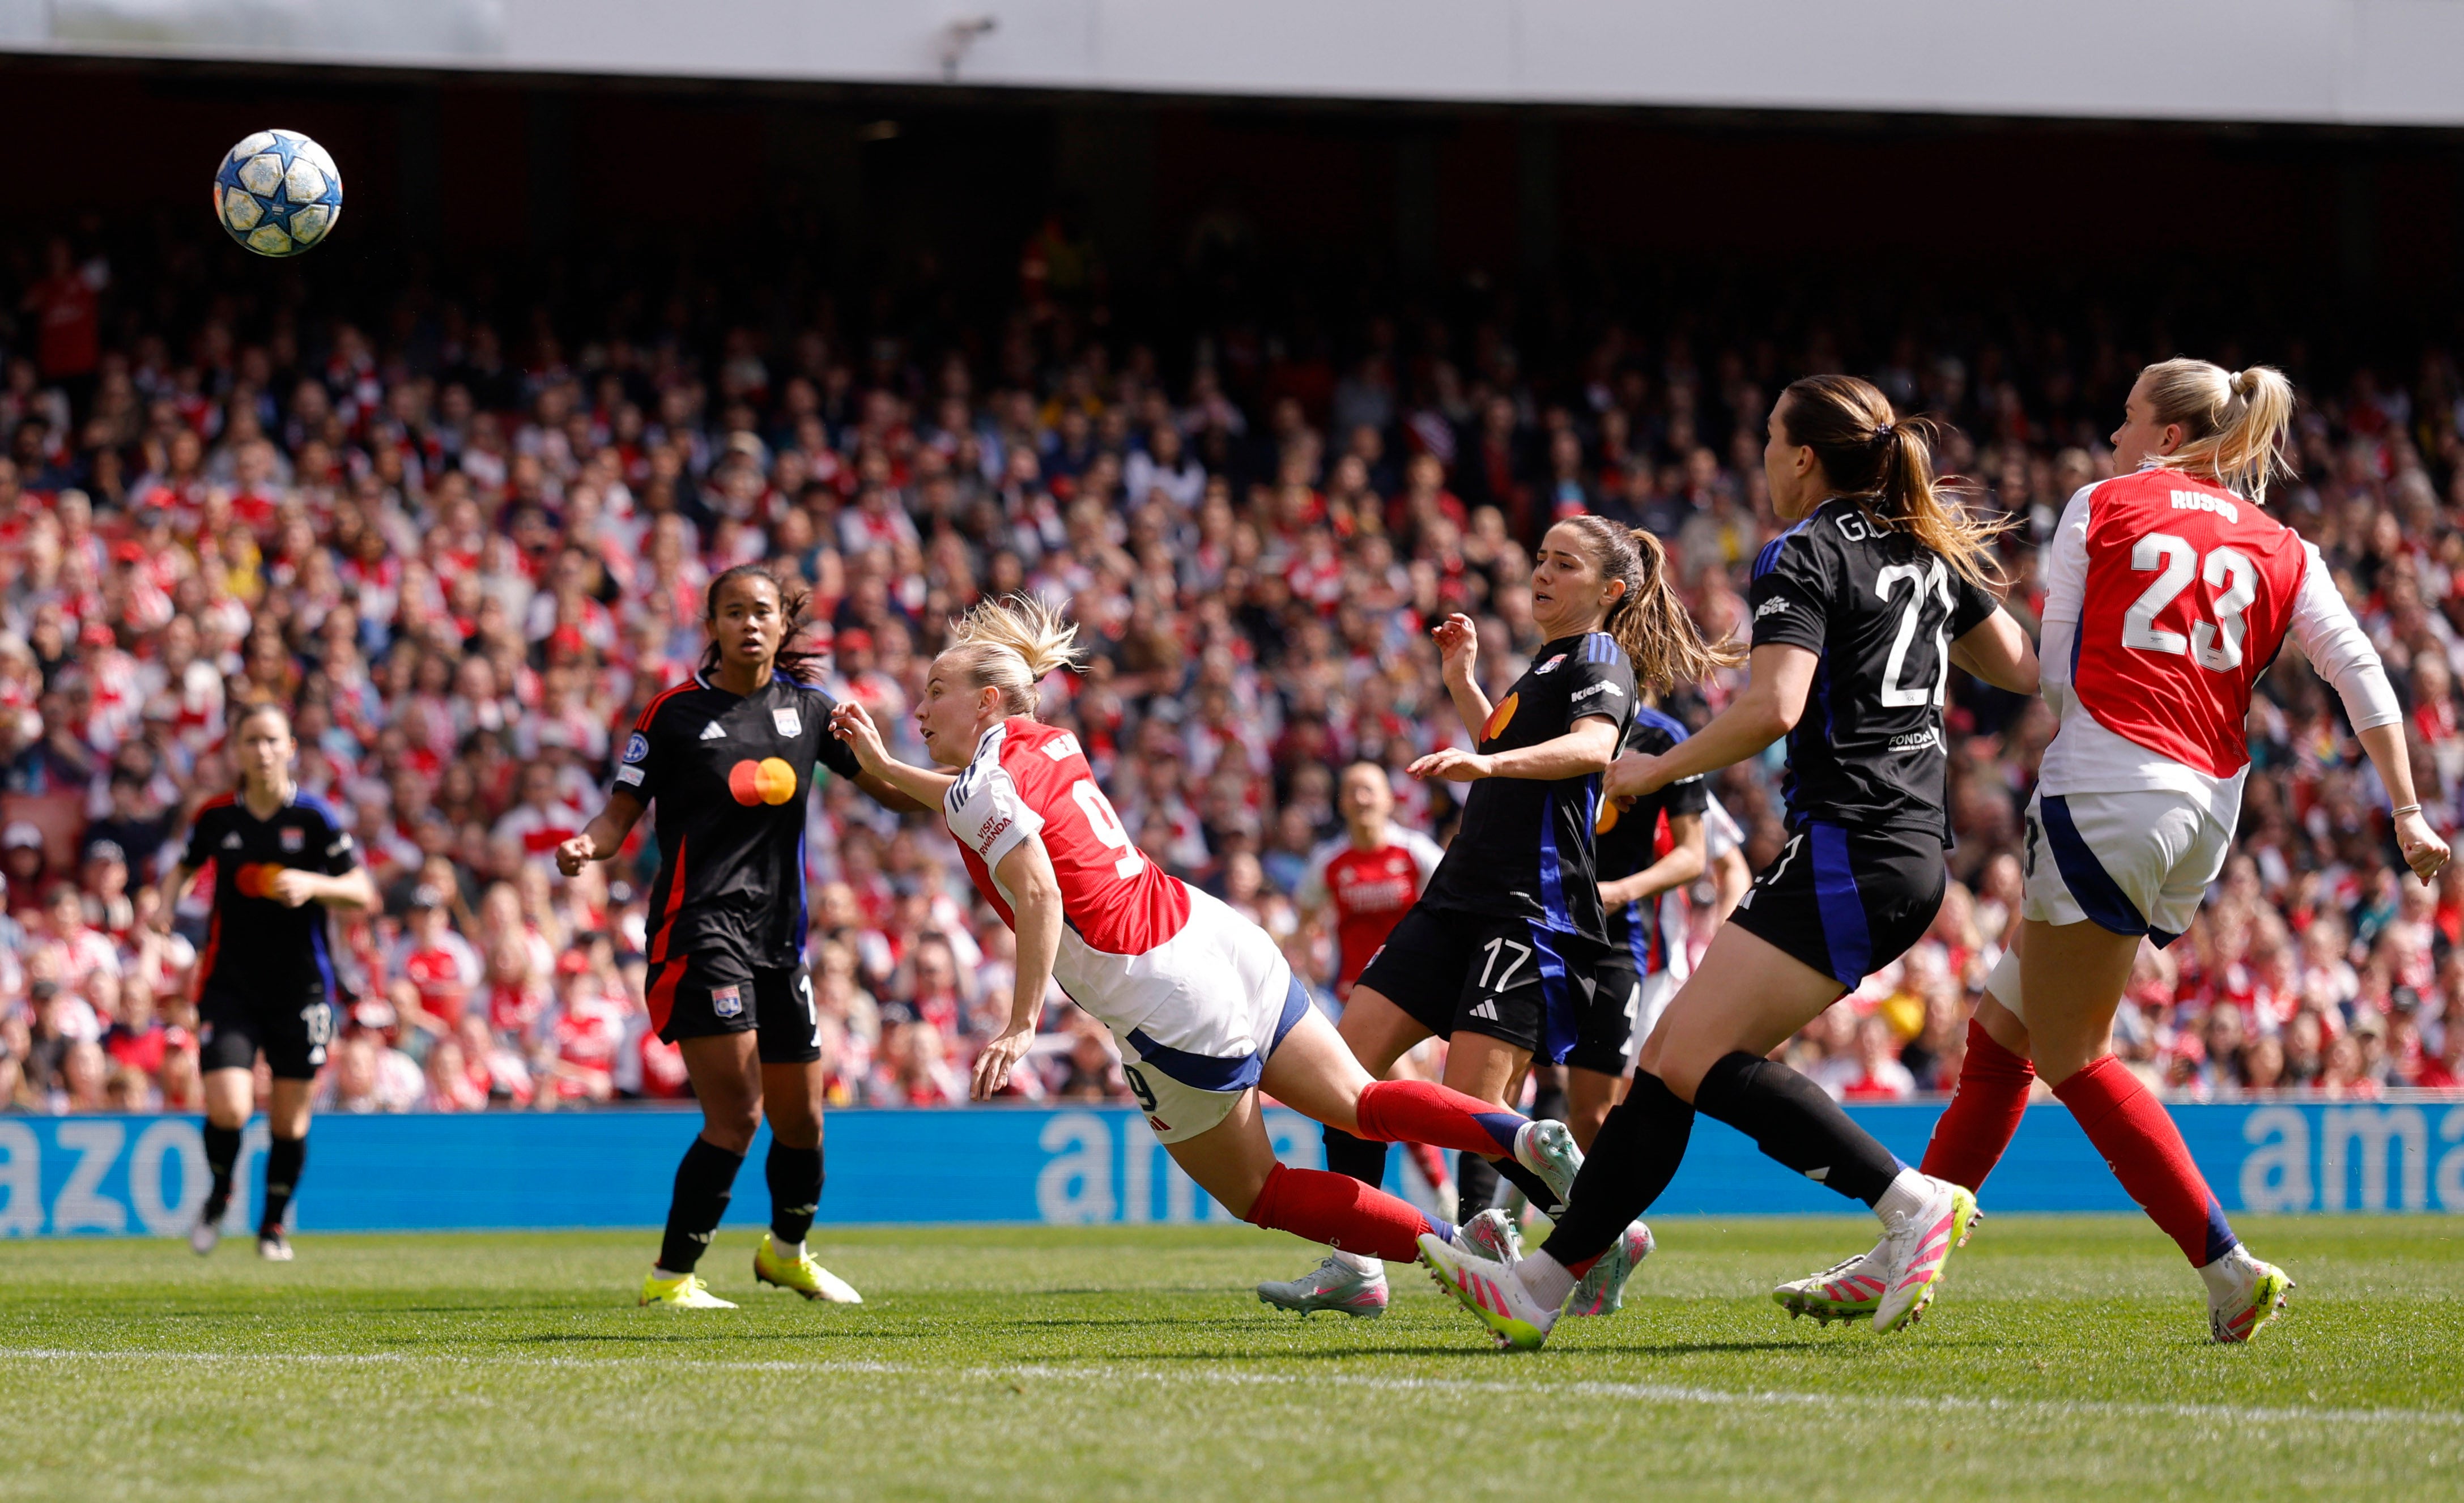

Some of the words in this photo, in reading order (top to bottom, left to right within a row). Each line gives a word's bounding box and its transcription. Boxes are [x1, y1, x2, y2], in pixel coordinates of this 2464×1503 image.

[2170, 490, 2238, 524] RUSSO
[2122, 532, 2259, 673] 23
[1875, 556, 1954, 707] 21
[977, 816, 995, 839] VISIT
[979, 818, 1012, 856] RWANDA
[1072, 780, 1145, 880] 9
[1479, 937, 1531, 993] 17
[1123, 1064, 1158, 1113] 9
